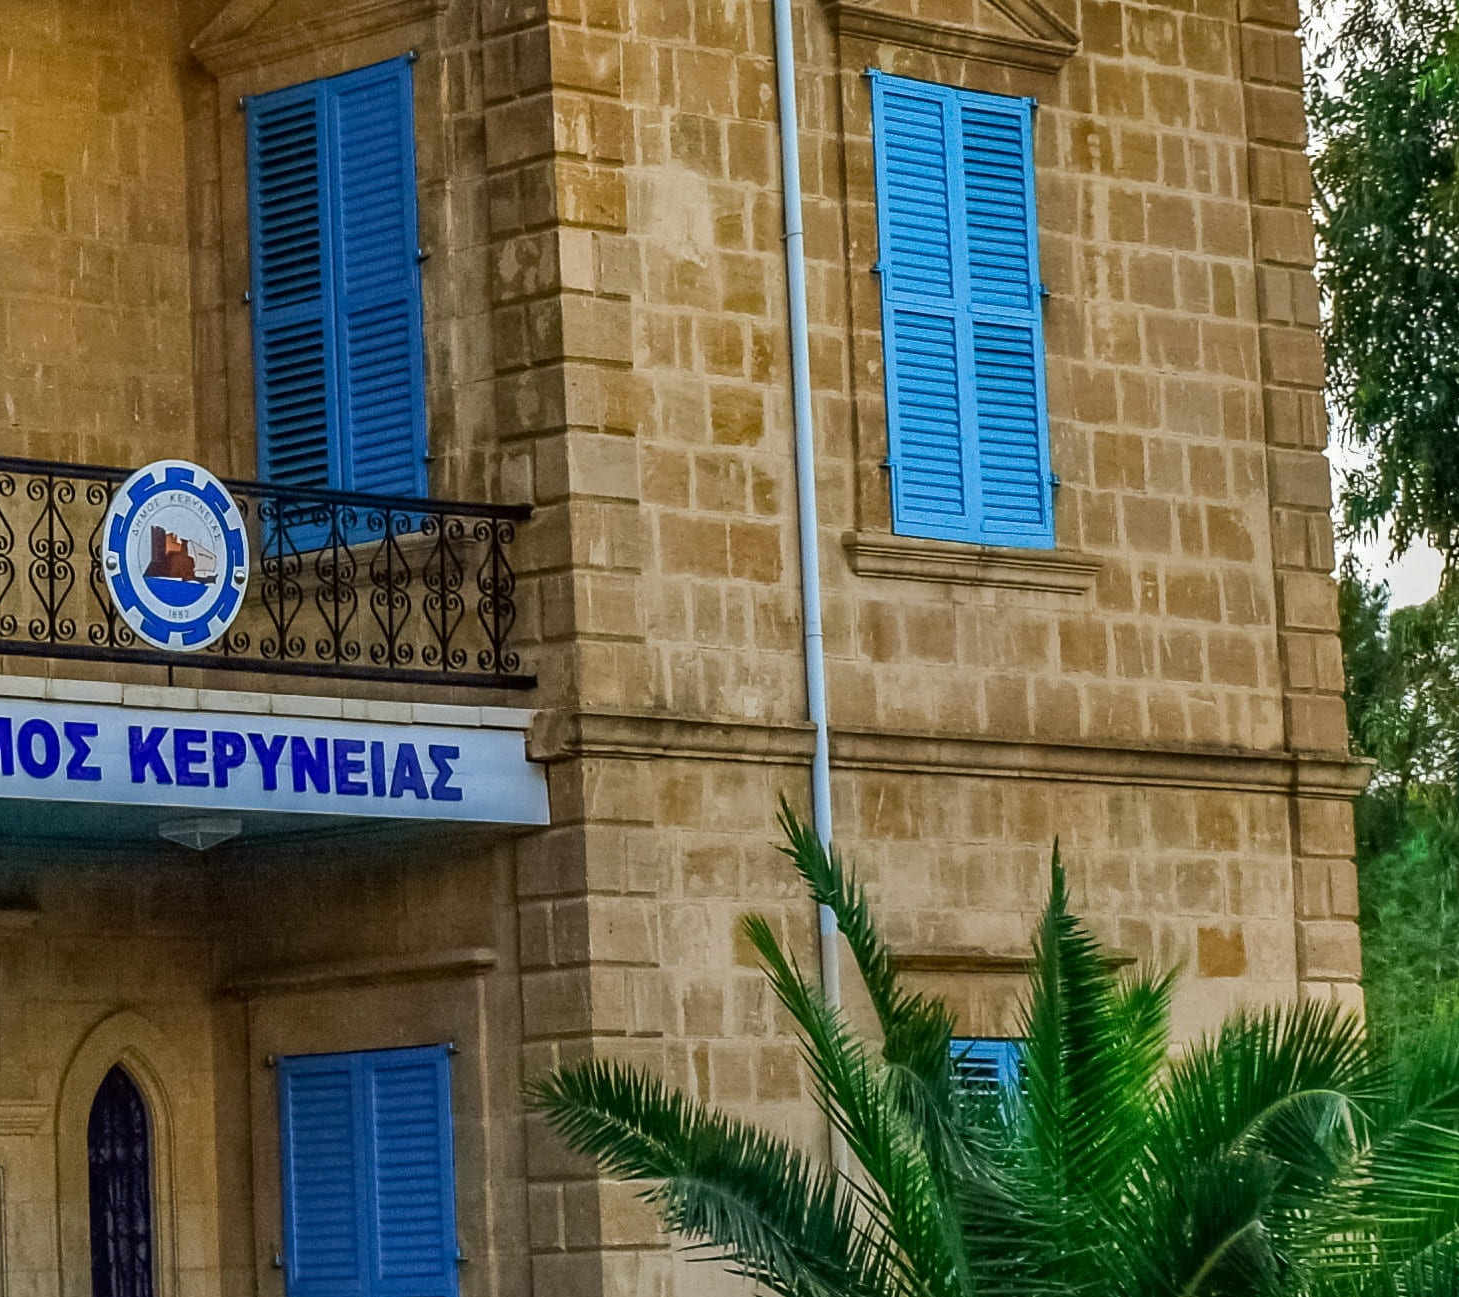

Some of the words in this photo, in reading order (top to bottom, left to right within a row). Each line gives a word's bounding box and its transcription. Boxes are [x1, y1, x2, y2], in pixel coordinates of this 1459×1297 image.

[131, 498, 160, 537] ΔΗΜΟΣ
[169, 493, 222, 542] ΚΕΡΥΝΕΙΑΣ
[127, 725, 464, 802] ΚΕΡΥΝΕΙΑΣ
